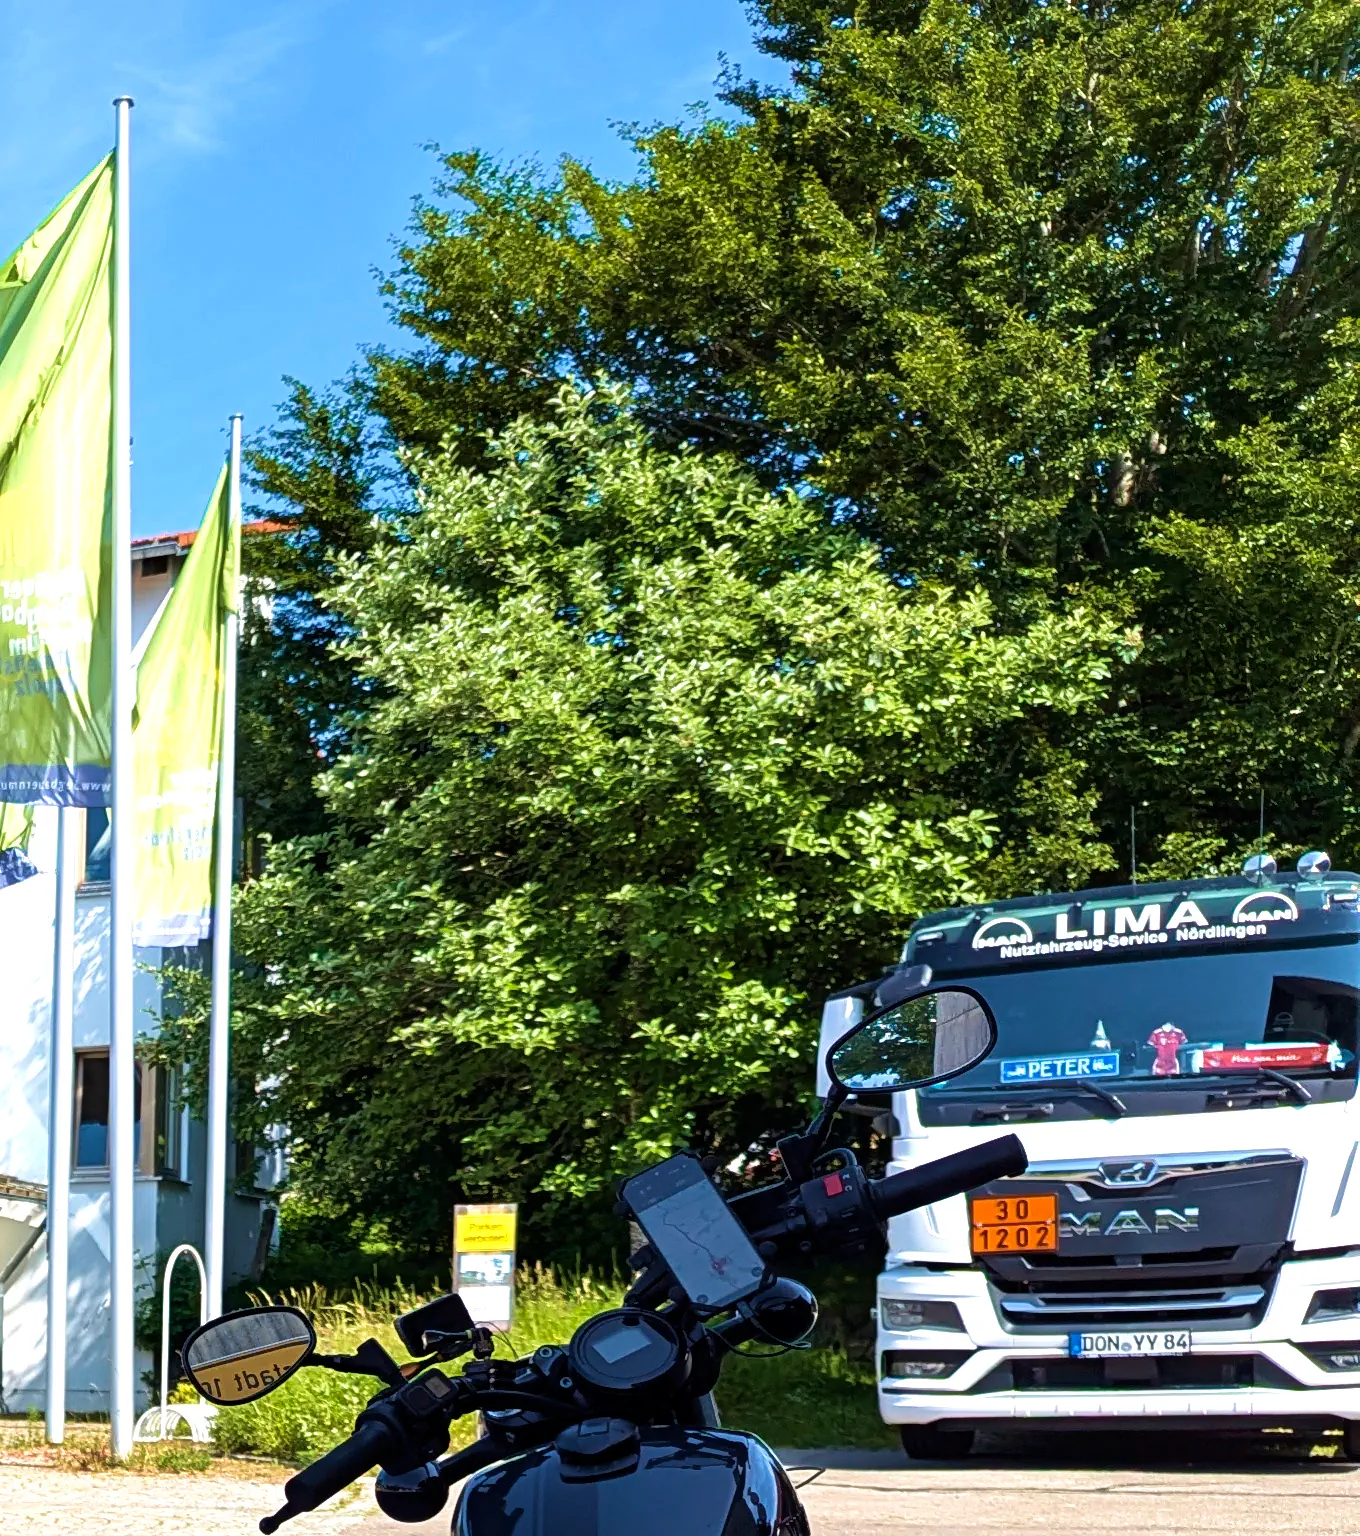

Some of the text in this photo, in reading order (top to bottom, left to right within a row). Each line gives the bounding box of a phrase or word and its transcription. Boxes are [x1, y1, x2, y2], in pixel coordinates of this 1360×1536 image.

[1055, 900, 1210, 939] LIMA
[1238, 909, 1292, 922] MAN
[978, 934, 1028, 949] MAN
[1000, 923, 1267, 959] Nutzfahrzeug-Service Nördlingen
[1028, 1058, 1091, 1078] PETER
[996, 1200, 1029, 1220] 30
[1059, 1207, 1200, 1237] MAN
[979, 1227, 1050, 1250] 1202
[1083, 1333, 1188, 1351] DON YY 84
